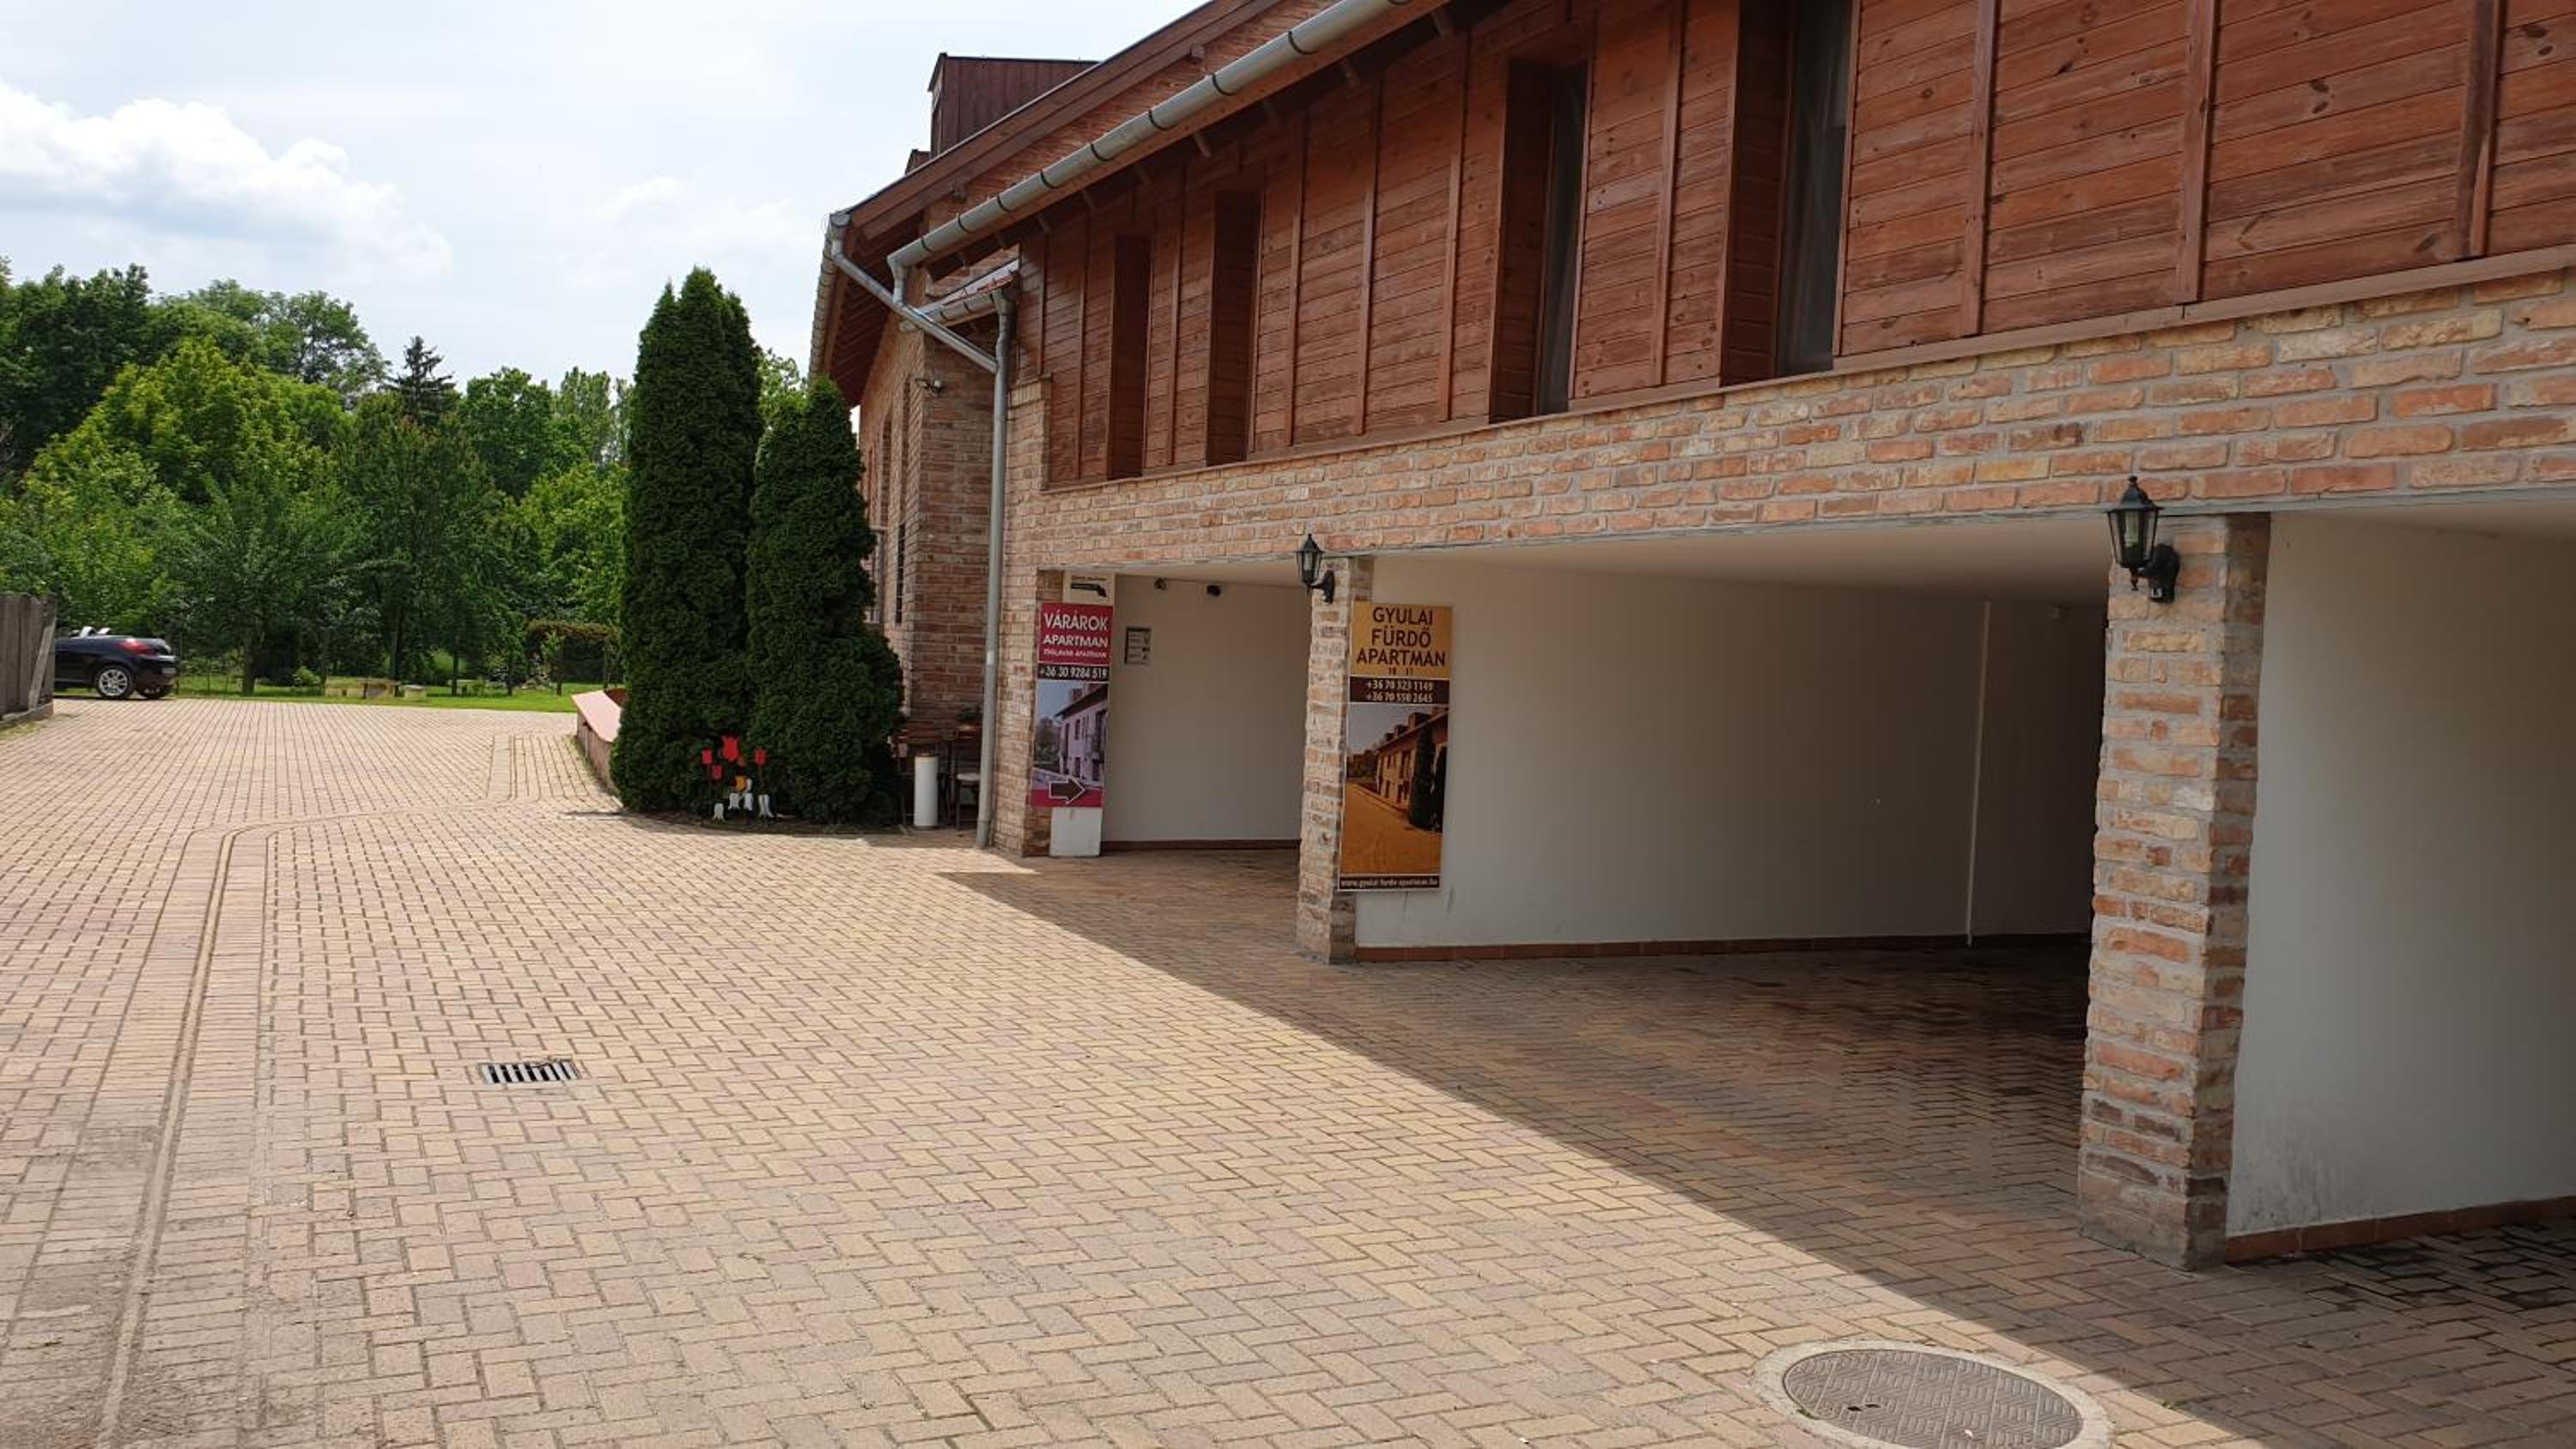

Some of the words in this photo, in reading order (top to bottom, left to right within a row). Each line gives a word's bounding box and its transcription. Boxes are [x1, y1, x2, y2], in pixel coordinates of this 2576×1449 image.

[1043, 609, 1109, 631] VÁRÁROK
[1373, 606, 1434, 626] GYULAI
[1042, 634, 1109, 648] APARTMAN
[1357, 647, 1446, 667] APARTMAN
[1058, 666, 1069, 677] 30
